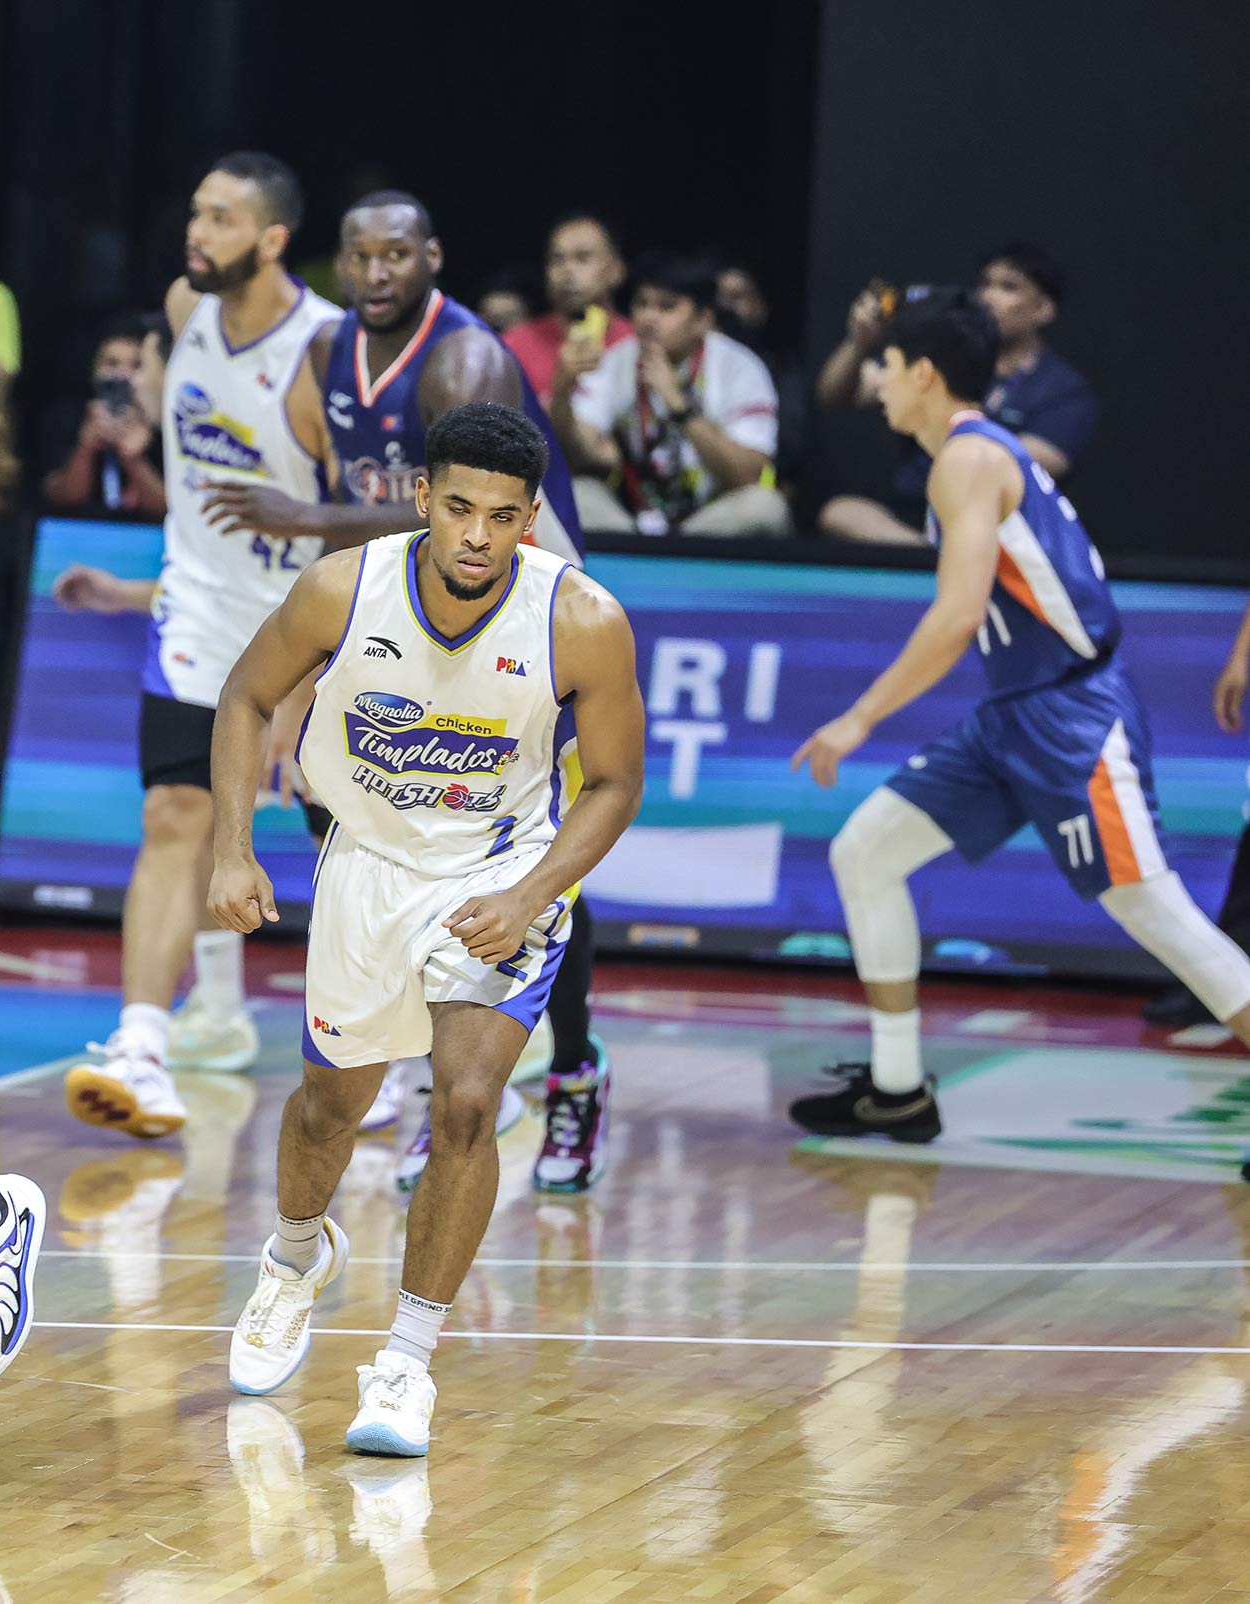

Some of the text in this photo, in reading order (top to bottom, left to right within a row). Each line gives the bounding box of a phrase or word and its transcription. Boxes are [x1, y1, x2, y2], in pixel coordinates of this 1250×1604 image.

[363, 646, 388, 660] ANTA
[495, 656, 527, 677] PBA
[352, 694, 423, 725] Magnolia
[435, 716, 493, 736] Chicken
[354, 726, 499, 773] Timplados
[314, 1015, 342, 1037] PBA
